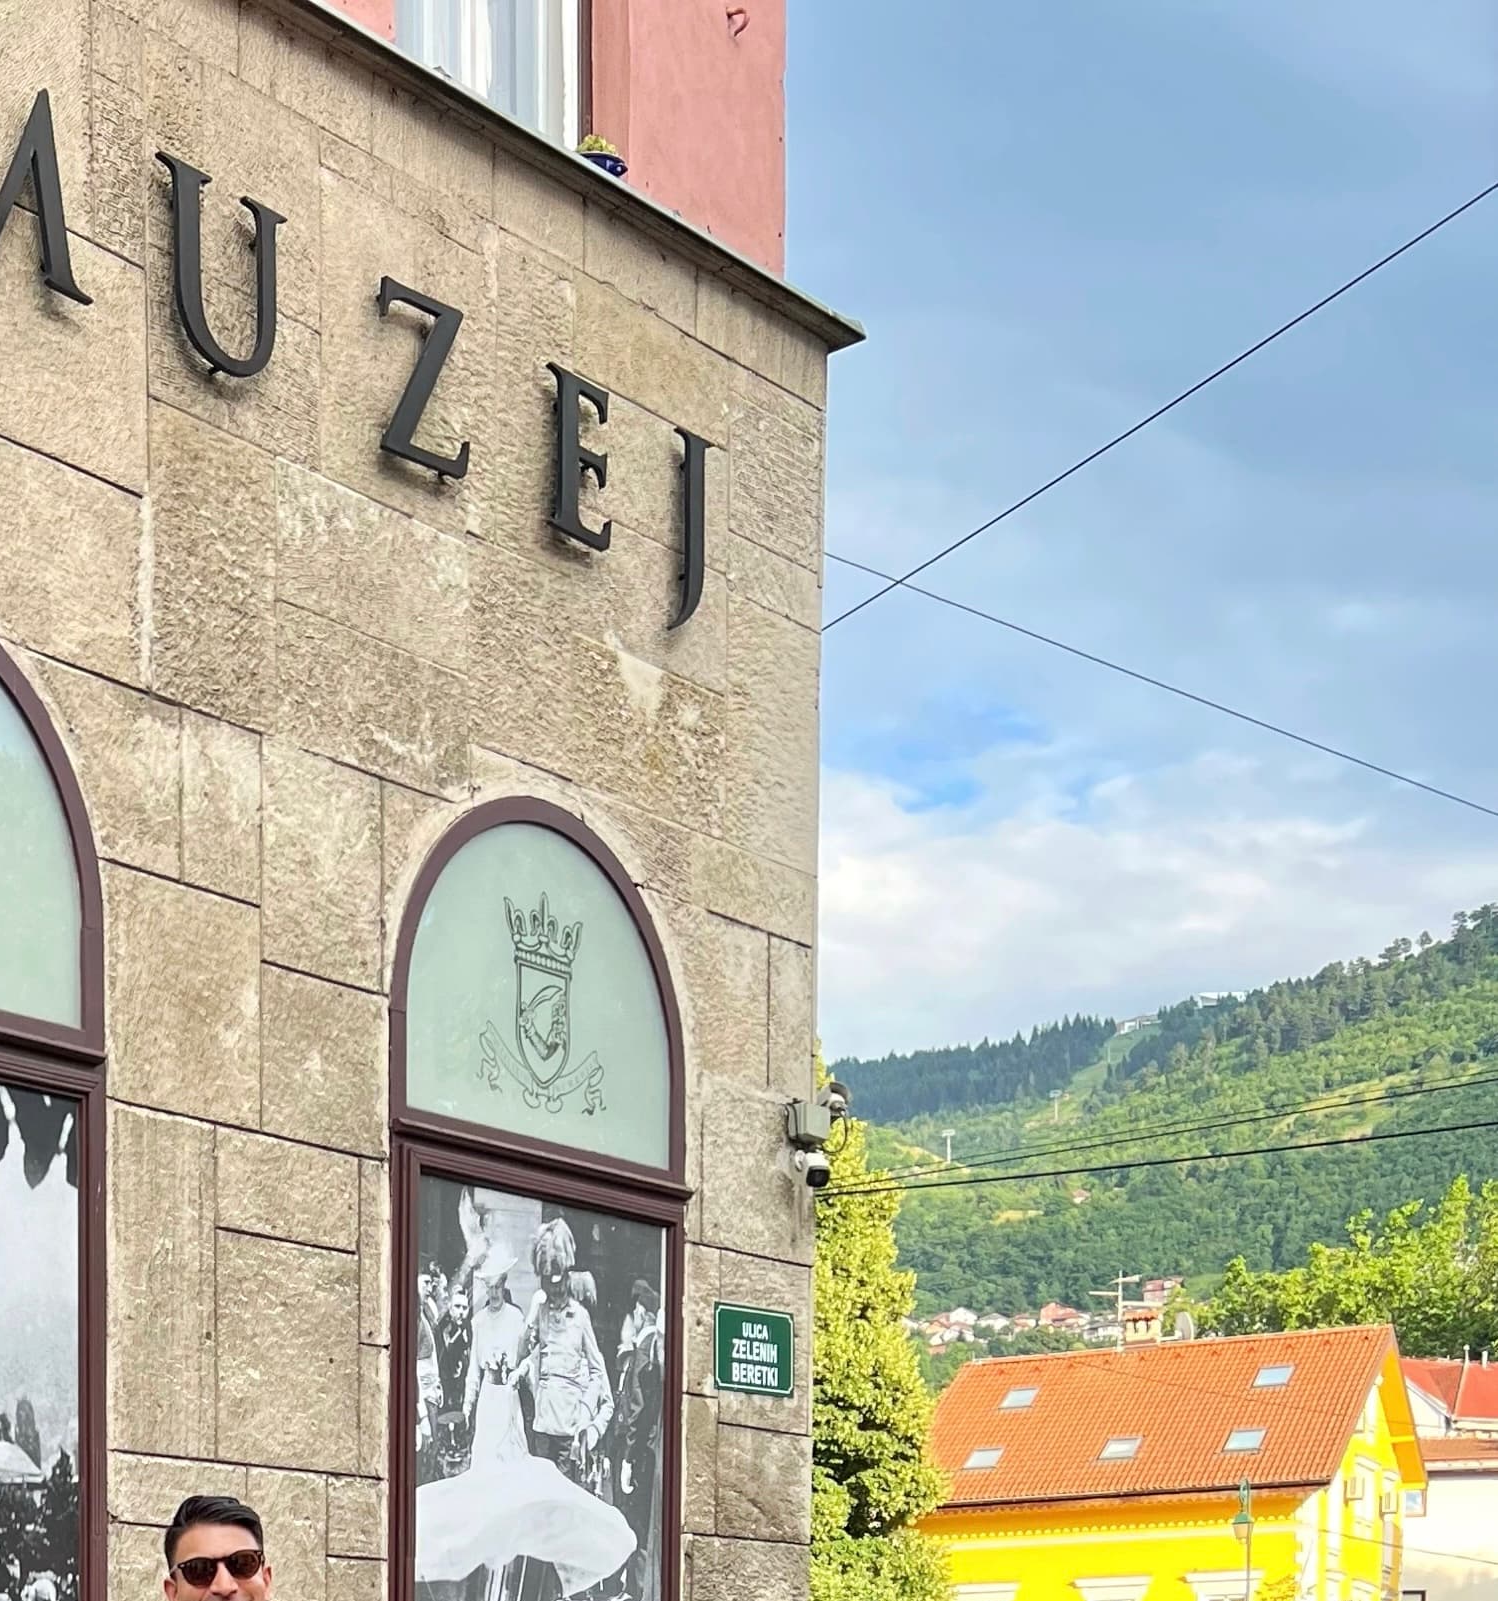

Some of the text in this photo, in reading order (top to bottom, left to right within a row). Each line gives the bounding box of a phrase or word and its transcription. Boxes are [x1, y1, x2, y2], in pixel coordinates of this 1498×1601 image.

[742, 1321, 769, 1340] ULICA
[731, 1338, 778, 1364] ZELENIH
[731, 1362, 779, 1387] BERETKI
